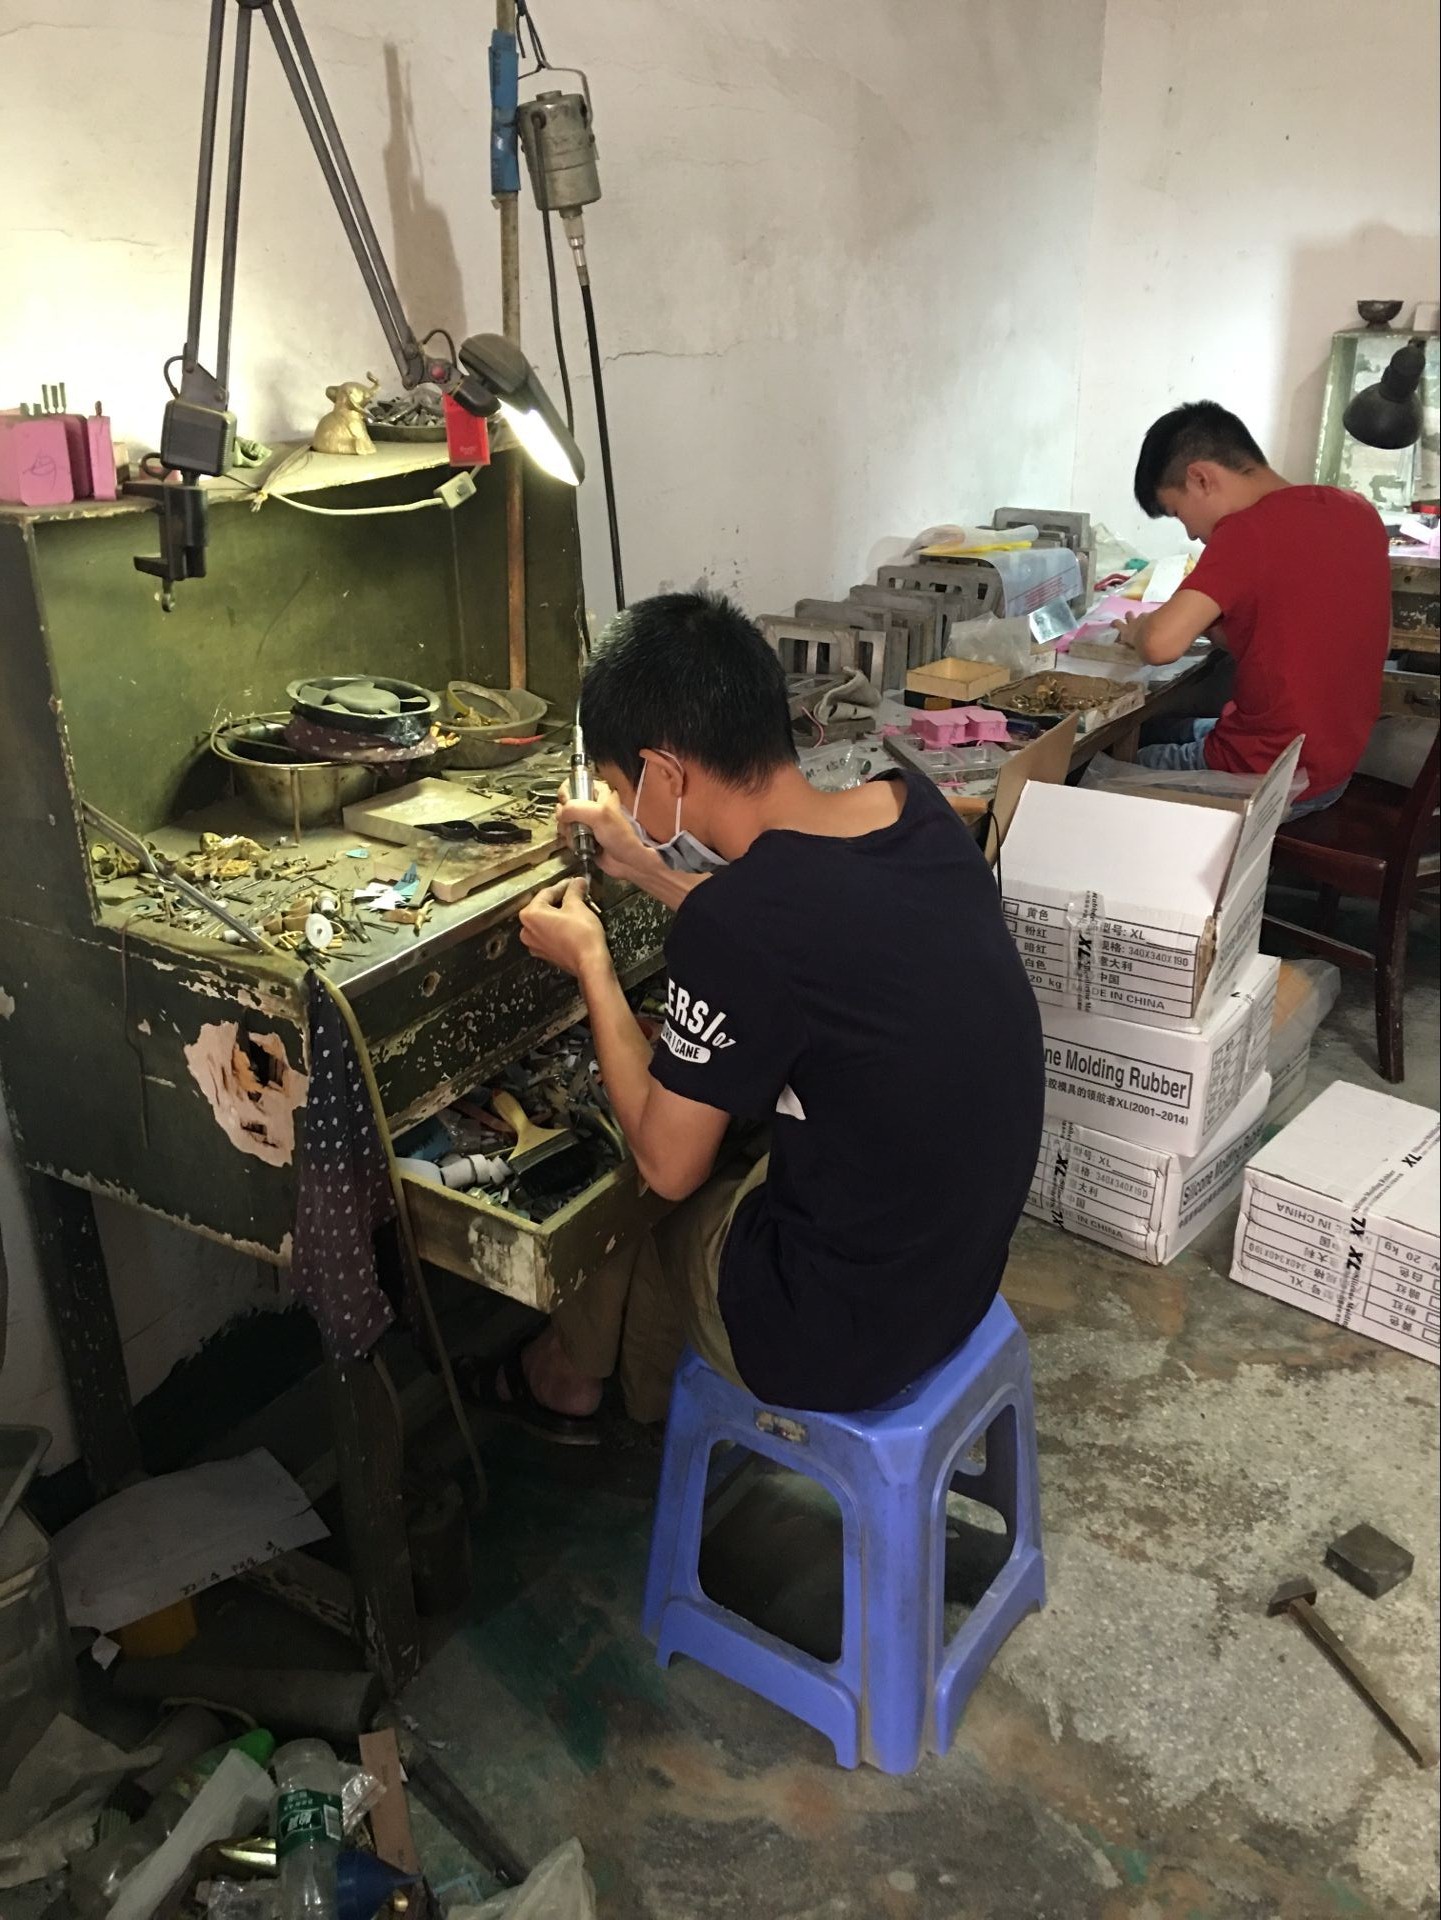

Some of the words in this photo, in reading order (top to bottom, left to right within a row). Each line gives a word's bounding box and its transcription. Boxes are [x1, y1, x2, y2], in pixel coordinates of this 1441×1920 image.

[1027, 907, 1049, 921] 黄色
[1025, 925, 1047, 939] 粉红
[1130, 929, 1145, 941] XL
[1024, 942, 1047, 954] 暗红
[1025, 958, 1046, 970] 白色
[1049, 977, 1062, 989] kg
[1110, 991, 1123, 1000] IN
[1126, 994, 1165, 1009] CHINA
[1066, 1049, 1124, 1088] Molding
[1129, 1066, 1187, 1099] Rubber
[1099, 1156, 1111, 1168] XL
[1401, 1153, 1423, 1168] XL
[1276, 1202, 1315, 1224] CHINA
[1091, 1220, 1123, 1239] CHINA
[1318, 1218, 1332, 1230] IN
[1384, 1241, 1399, 1255] kg
[1406, 1252, 1421, 1264] 20
[1289, 1275, 1304, 1287] XL
